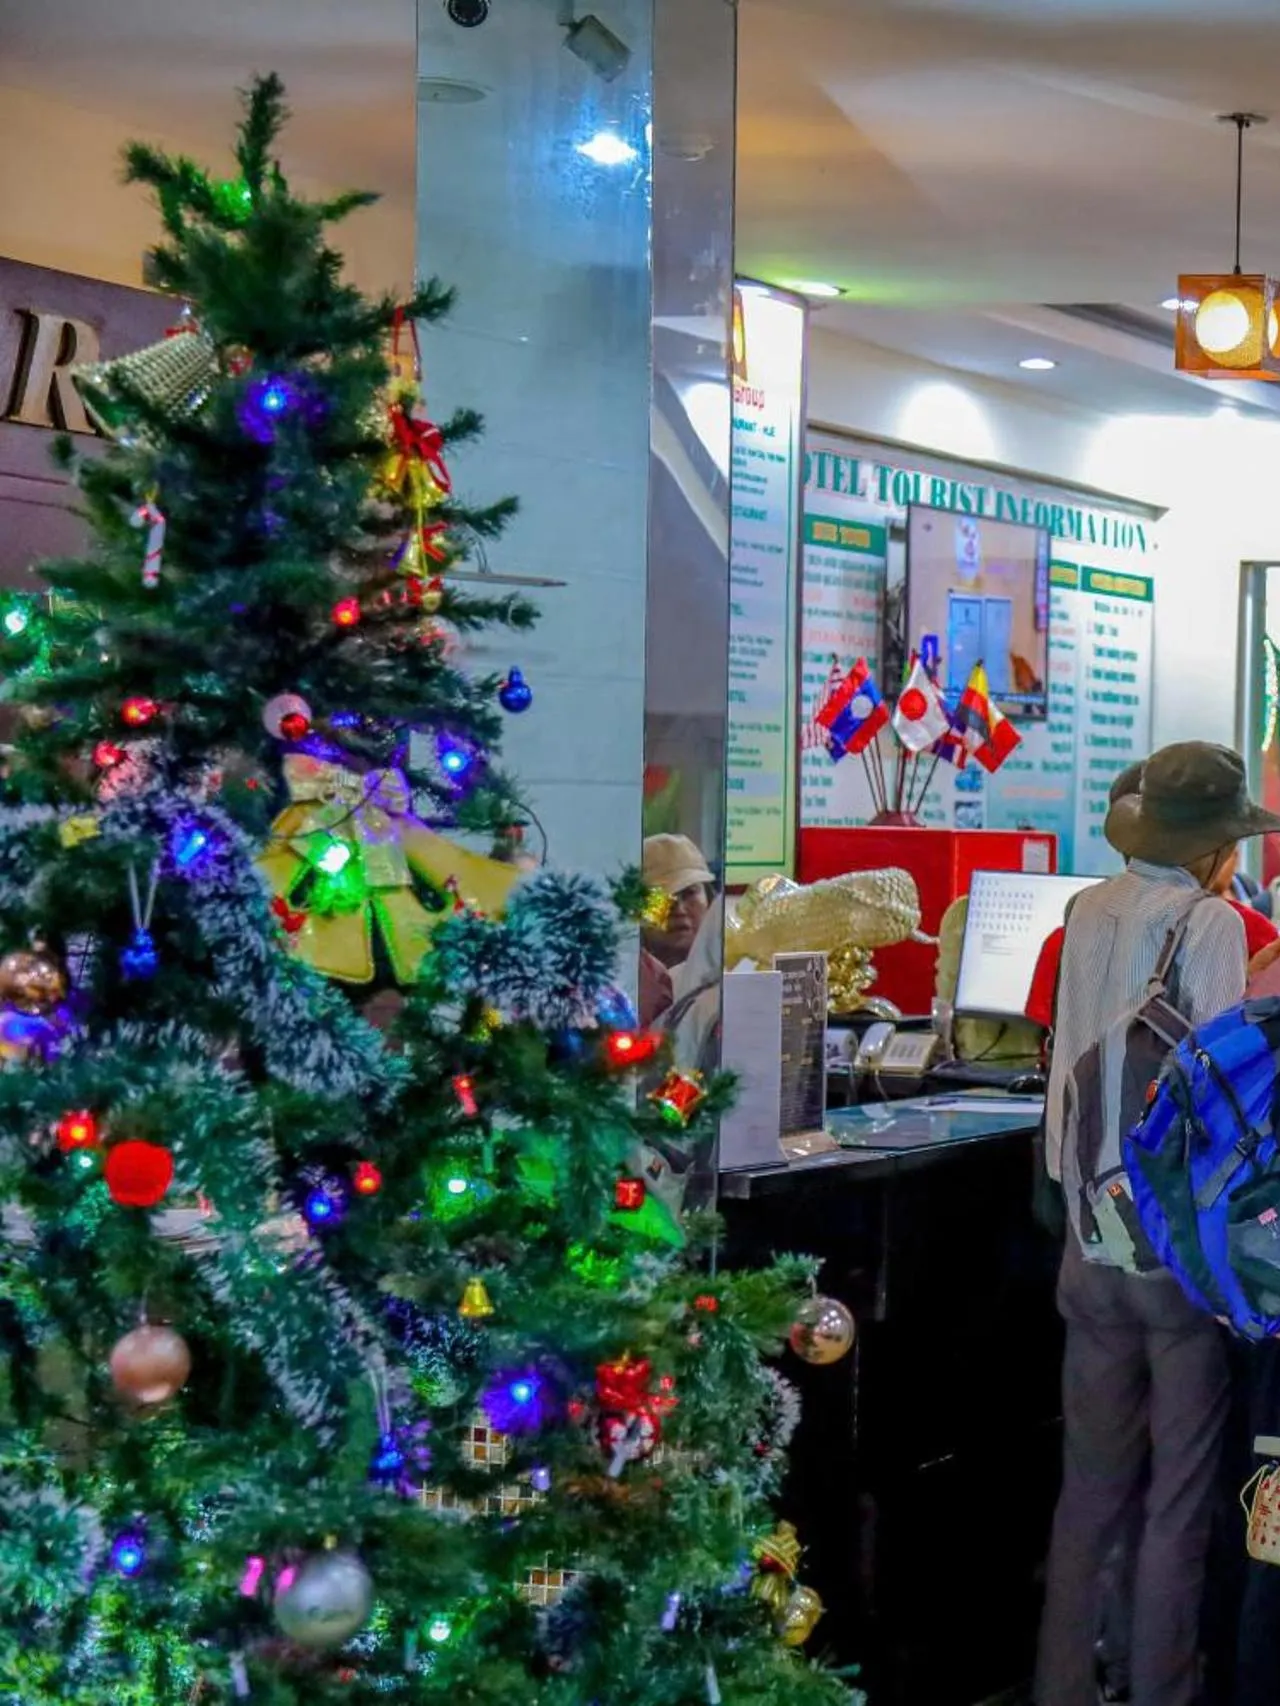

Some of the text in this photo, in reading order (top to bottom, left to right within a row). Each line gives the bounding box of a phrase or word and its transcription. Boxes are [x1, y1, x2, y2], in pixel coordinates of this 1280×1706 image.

[803, 450, 866, 497] TEL
[874, 464, 985, 514] TOURIST
[995, 490, 1147, 553] INFORMATION
